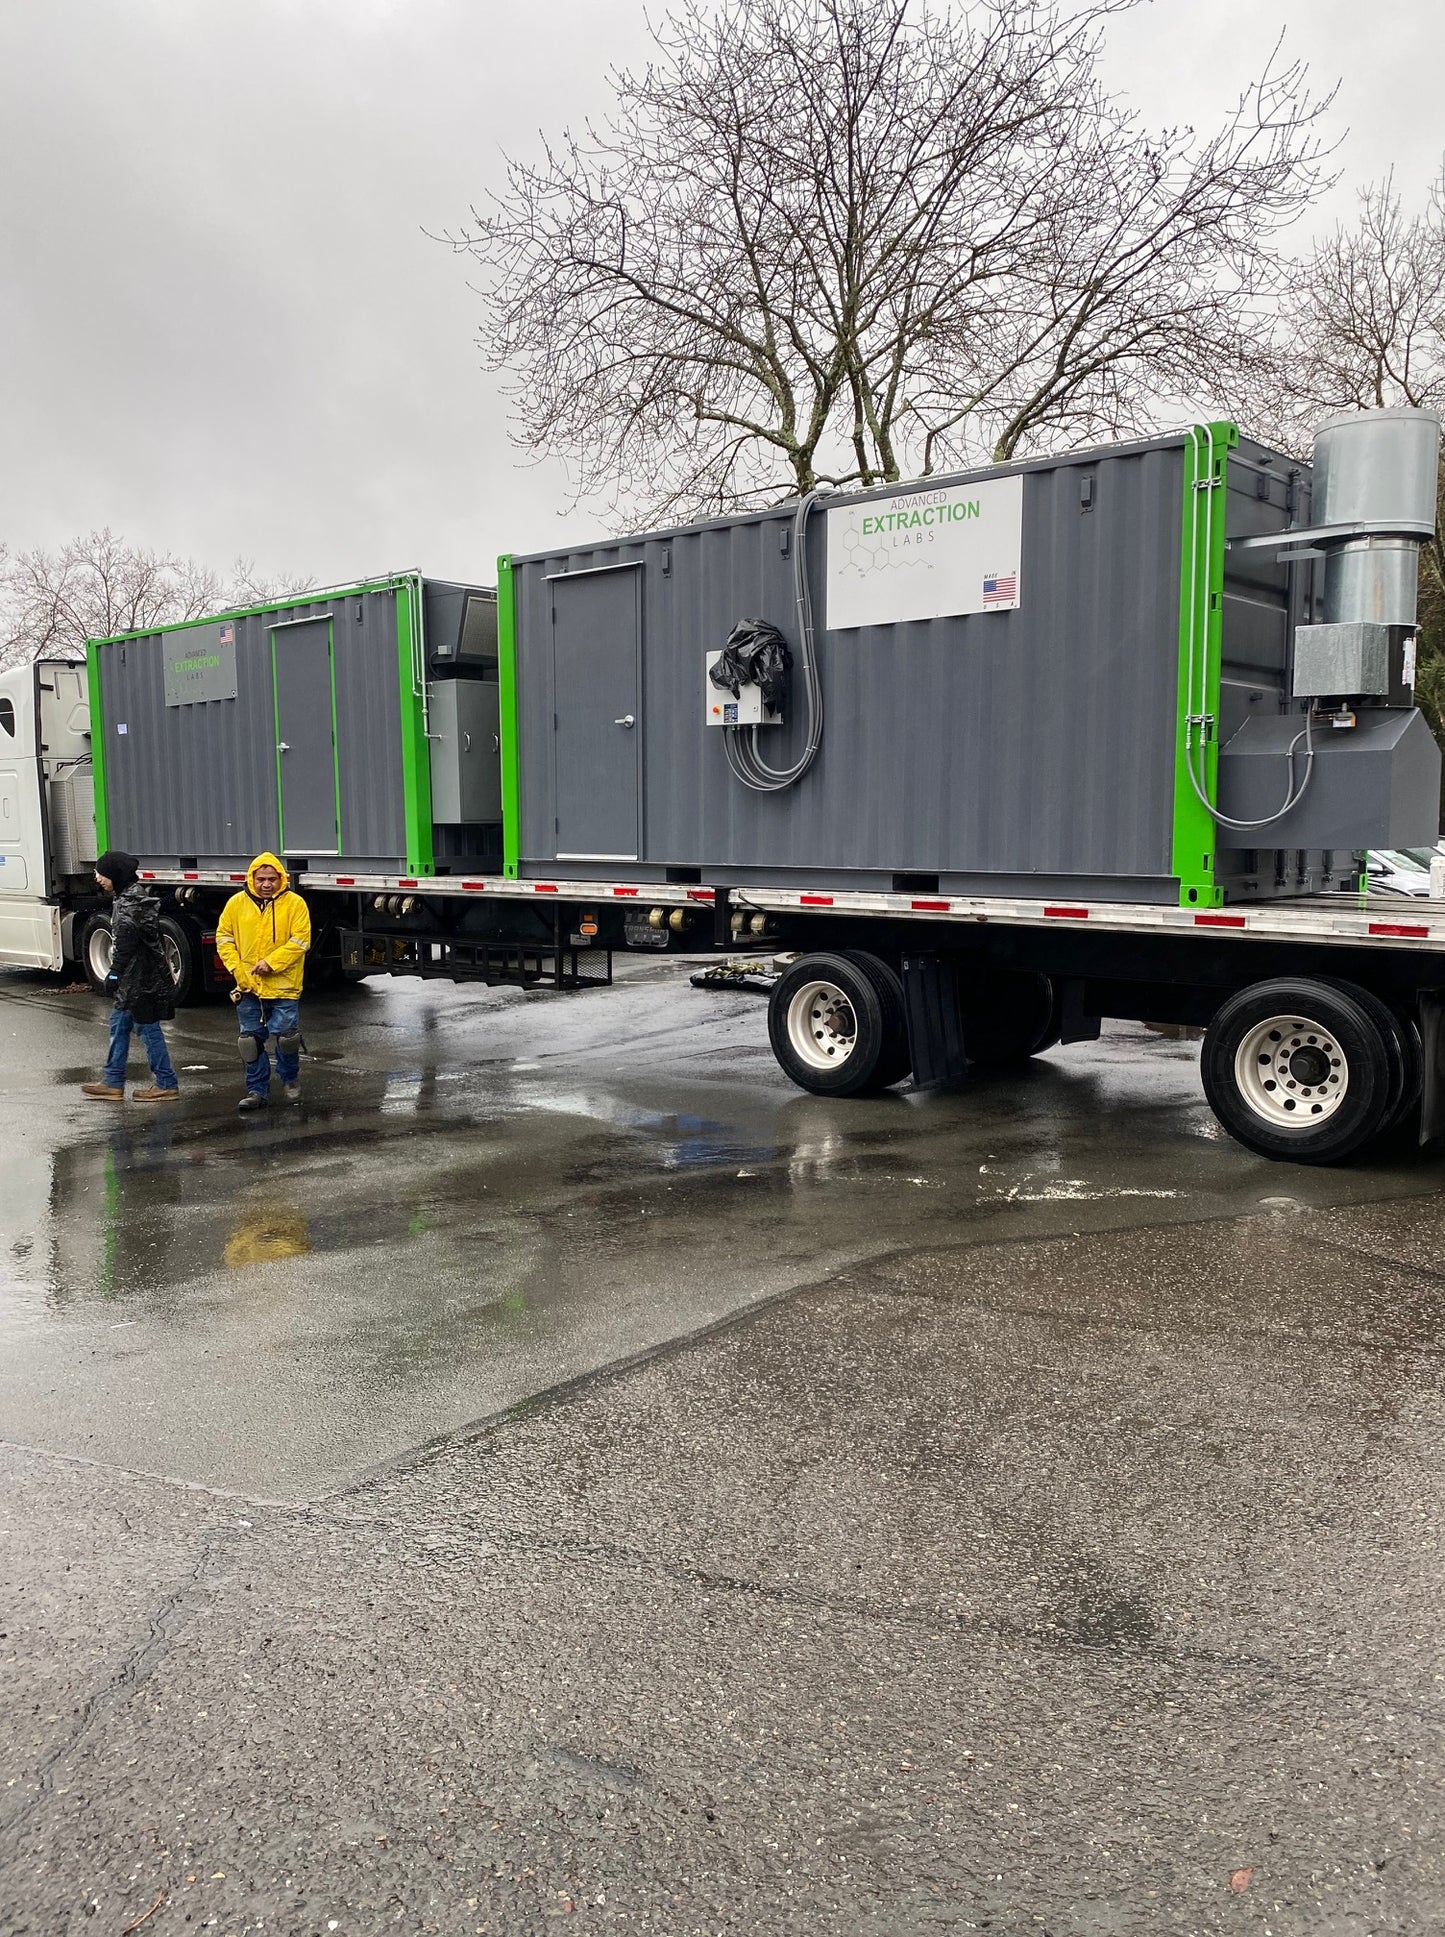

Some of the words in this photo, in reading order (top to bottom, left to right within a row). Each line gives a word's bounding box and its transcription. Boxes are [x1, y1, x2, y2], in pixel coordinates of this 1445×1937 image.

[891, 491, 947, 510] ADVANCED
[862, 501, 980, 535] EXTRACTION
[893, 531, 934, 547] LABS
[174, 655, 219, 672] EXTRACTION
